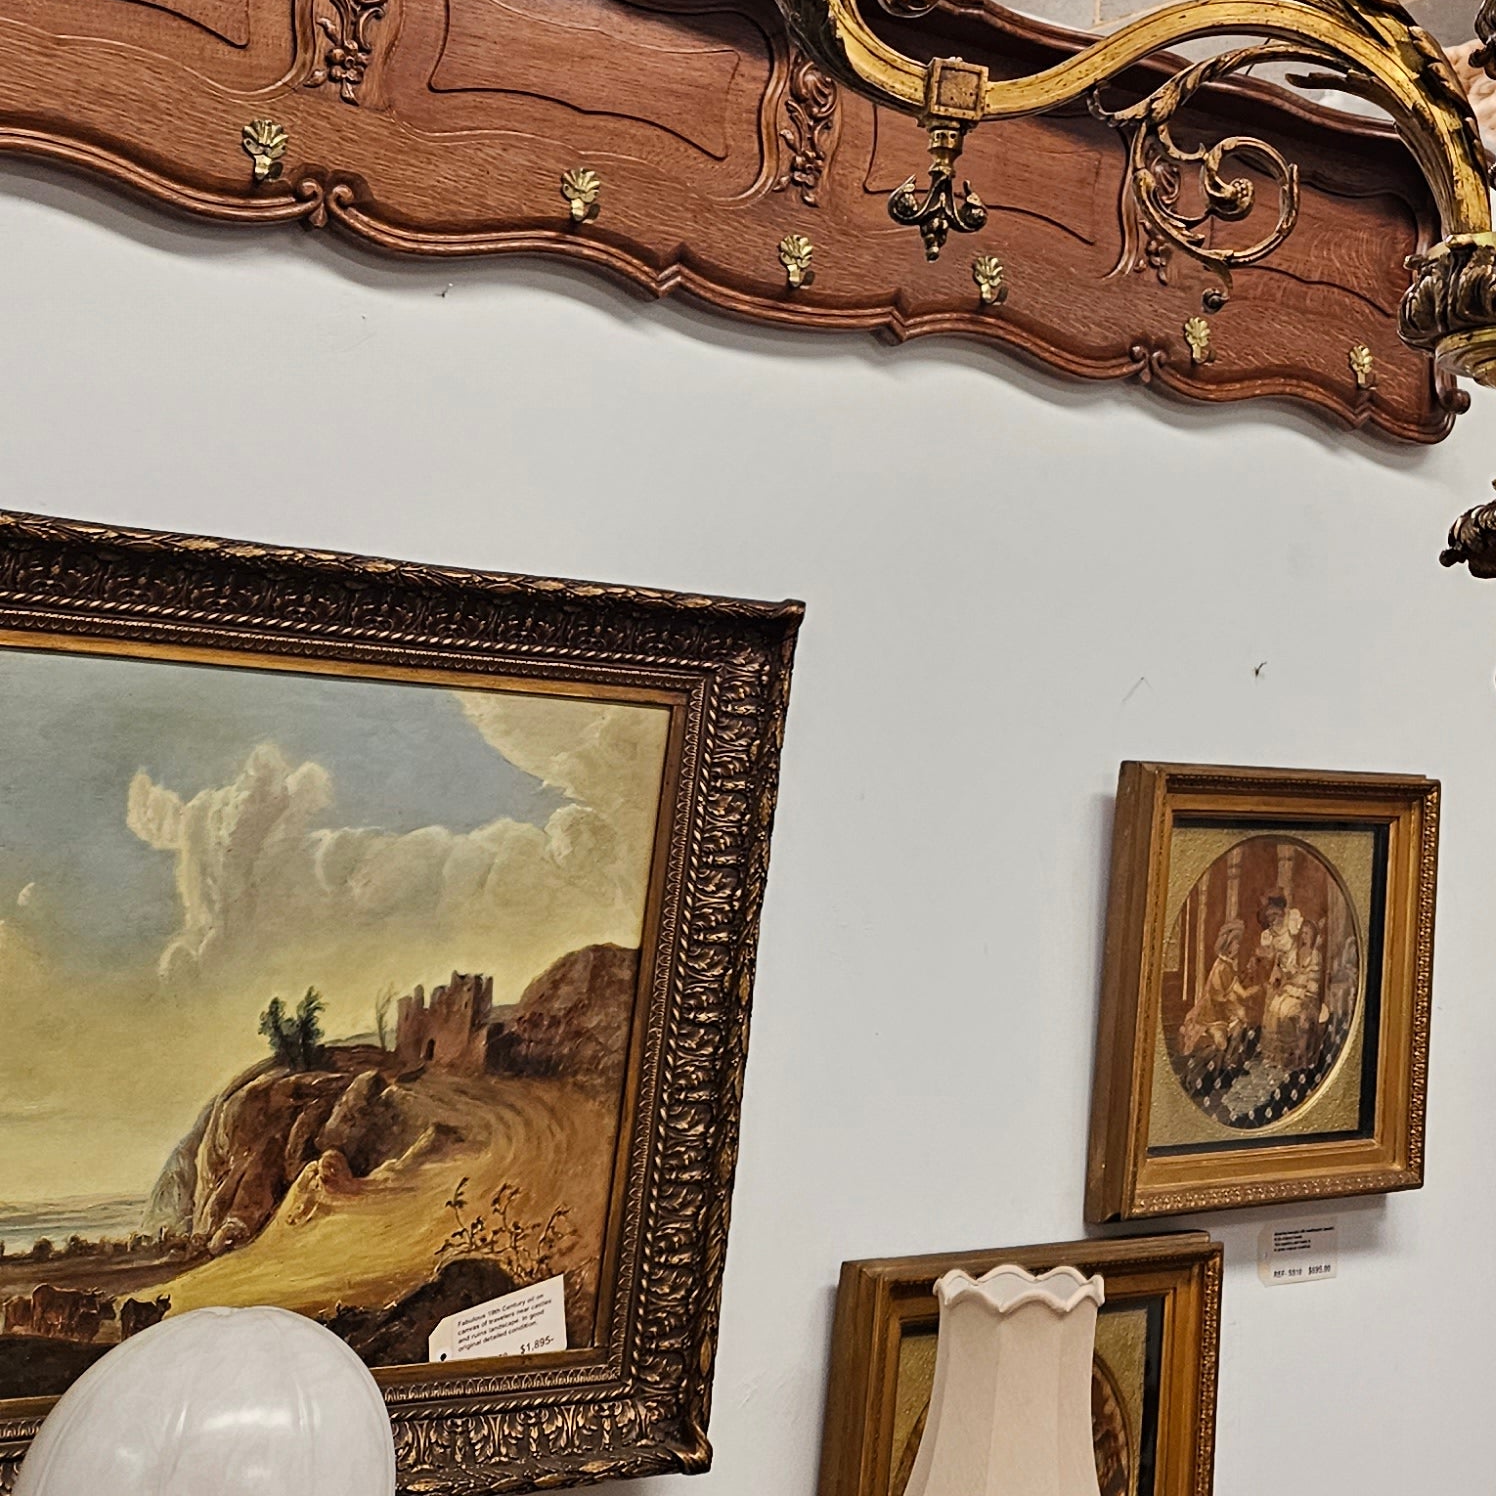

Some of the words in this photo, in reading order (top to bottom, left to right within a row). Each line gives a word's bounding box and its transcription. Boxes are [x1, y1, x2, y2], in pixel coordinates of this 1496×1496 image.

[502, 1300, 525, 1312] Century
[458, 1335, 470, 1344] and
[530, 1309, 545, 1320] good
[458, 1324, 480, 1335] canvas
[458, 1339, 482, 1352] original
